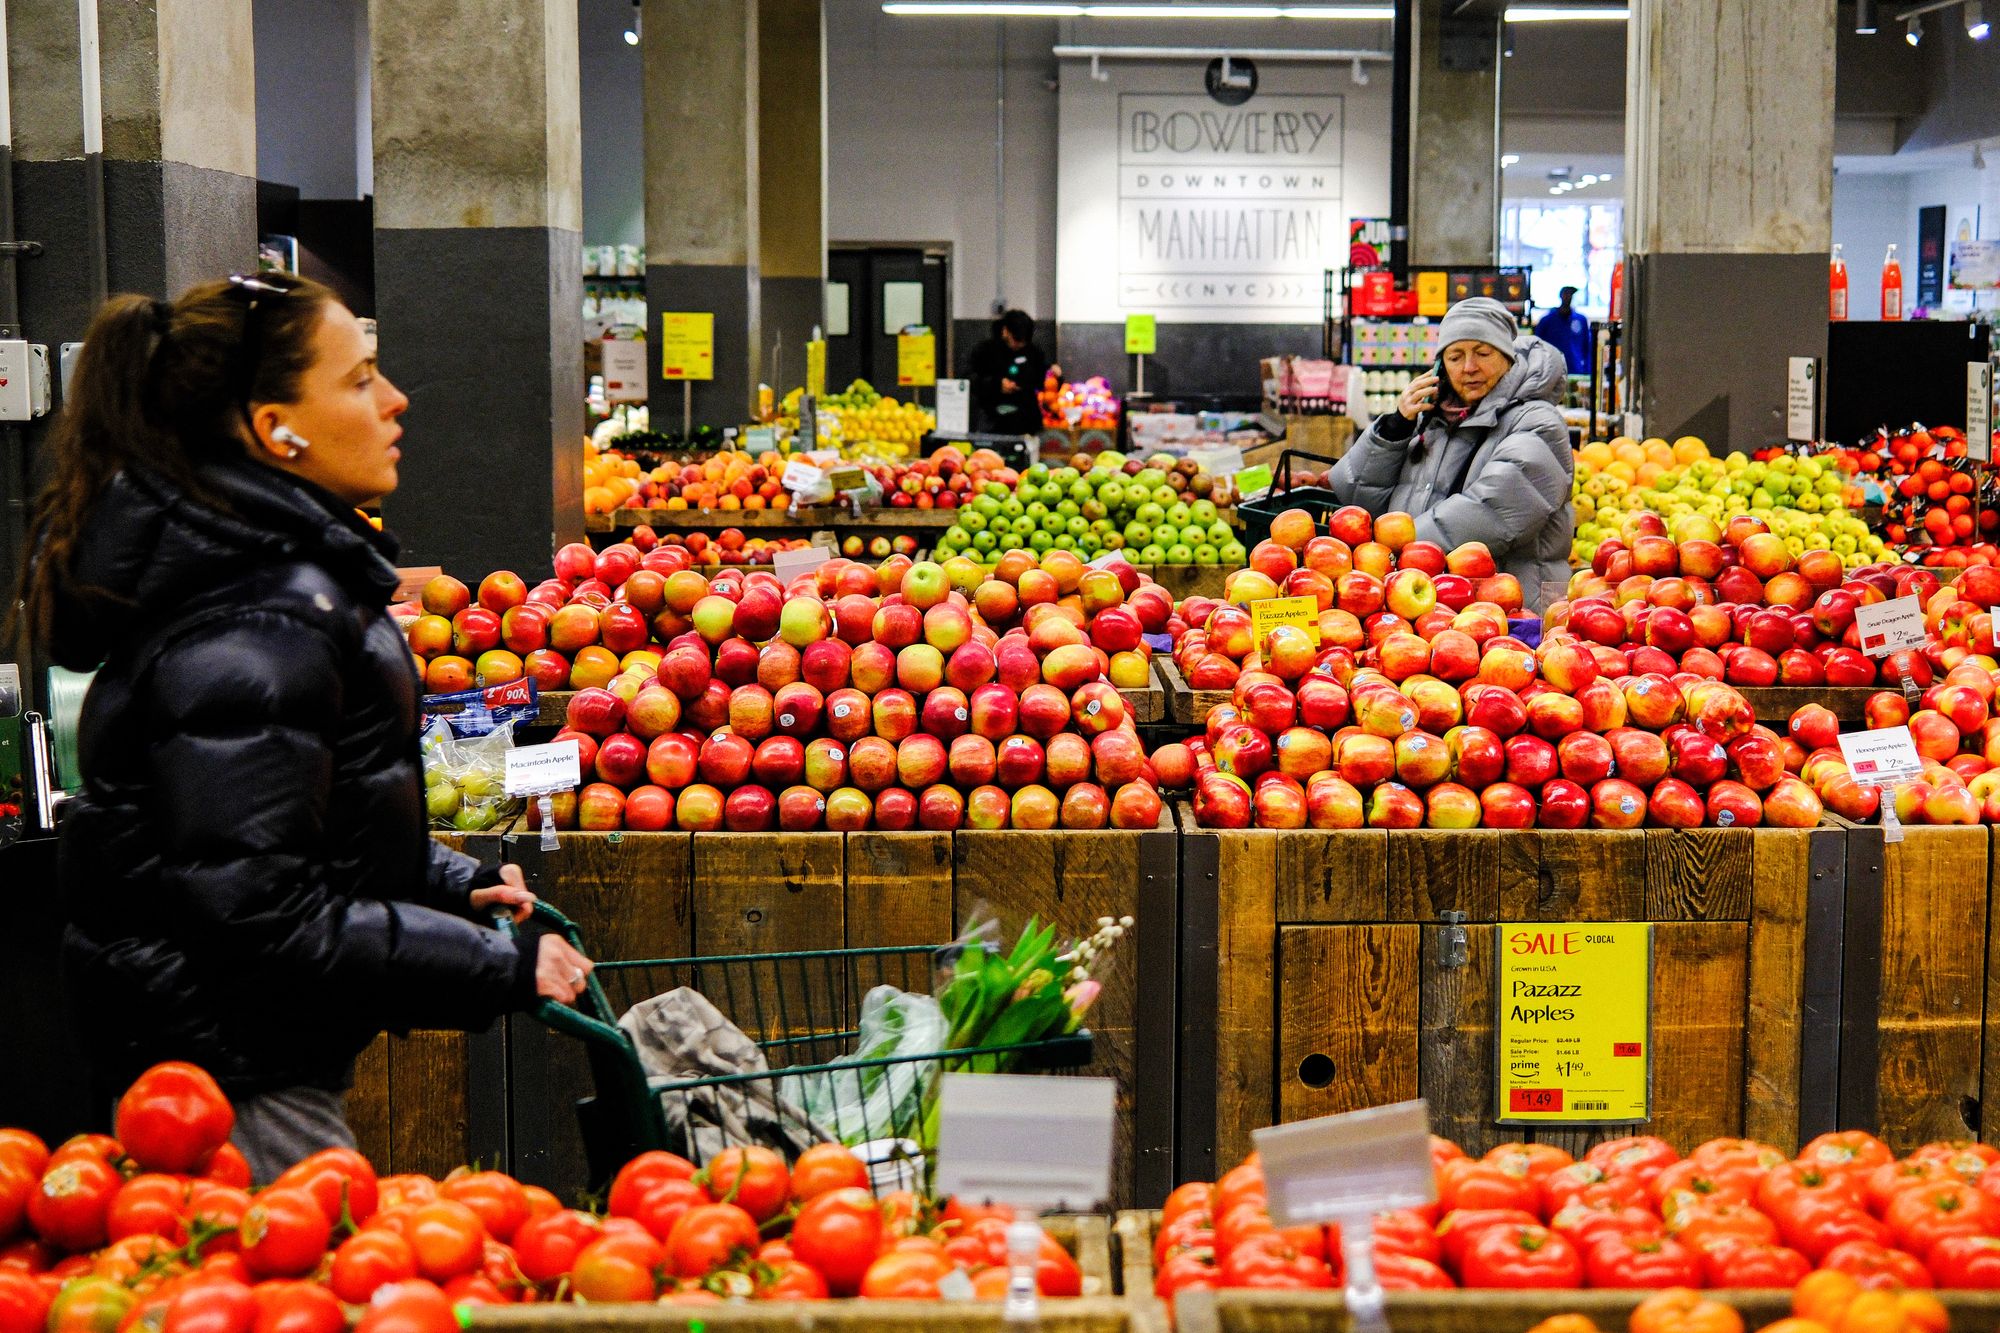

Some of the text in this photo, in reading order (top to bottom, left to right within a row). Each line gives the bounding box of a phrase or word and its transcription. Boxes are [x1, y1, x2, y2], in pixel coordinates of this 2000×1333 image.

[1131, 111, 1333, 153] BOWERY
[1137, 175, 1324, 188] DOWNTOWN
[1138, 209, 1322, 260] MANHATTAN
[1203, 284, 1257, 296] NYC
[552, 755, 574, 763] Apple
[1510, 931, 1616, 955] SALE LOCAL
[1512, 980, 1582, 998] Pazazz
[1510, 1005, 1575, 1024] Apples
[1510, 1060, 1540, 1070] prime
